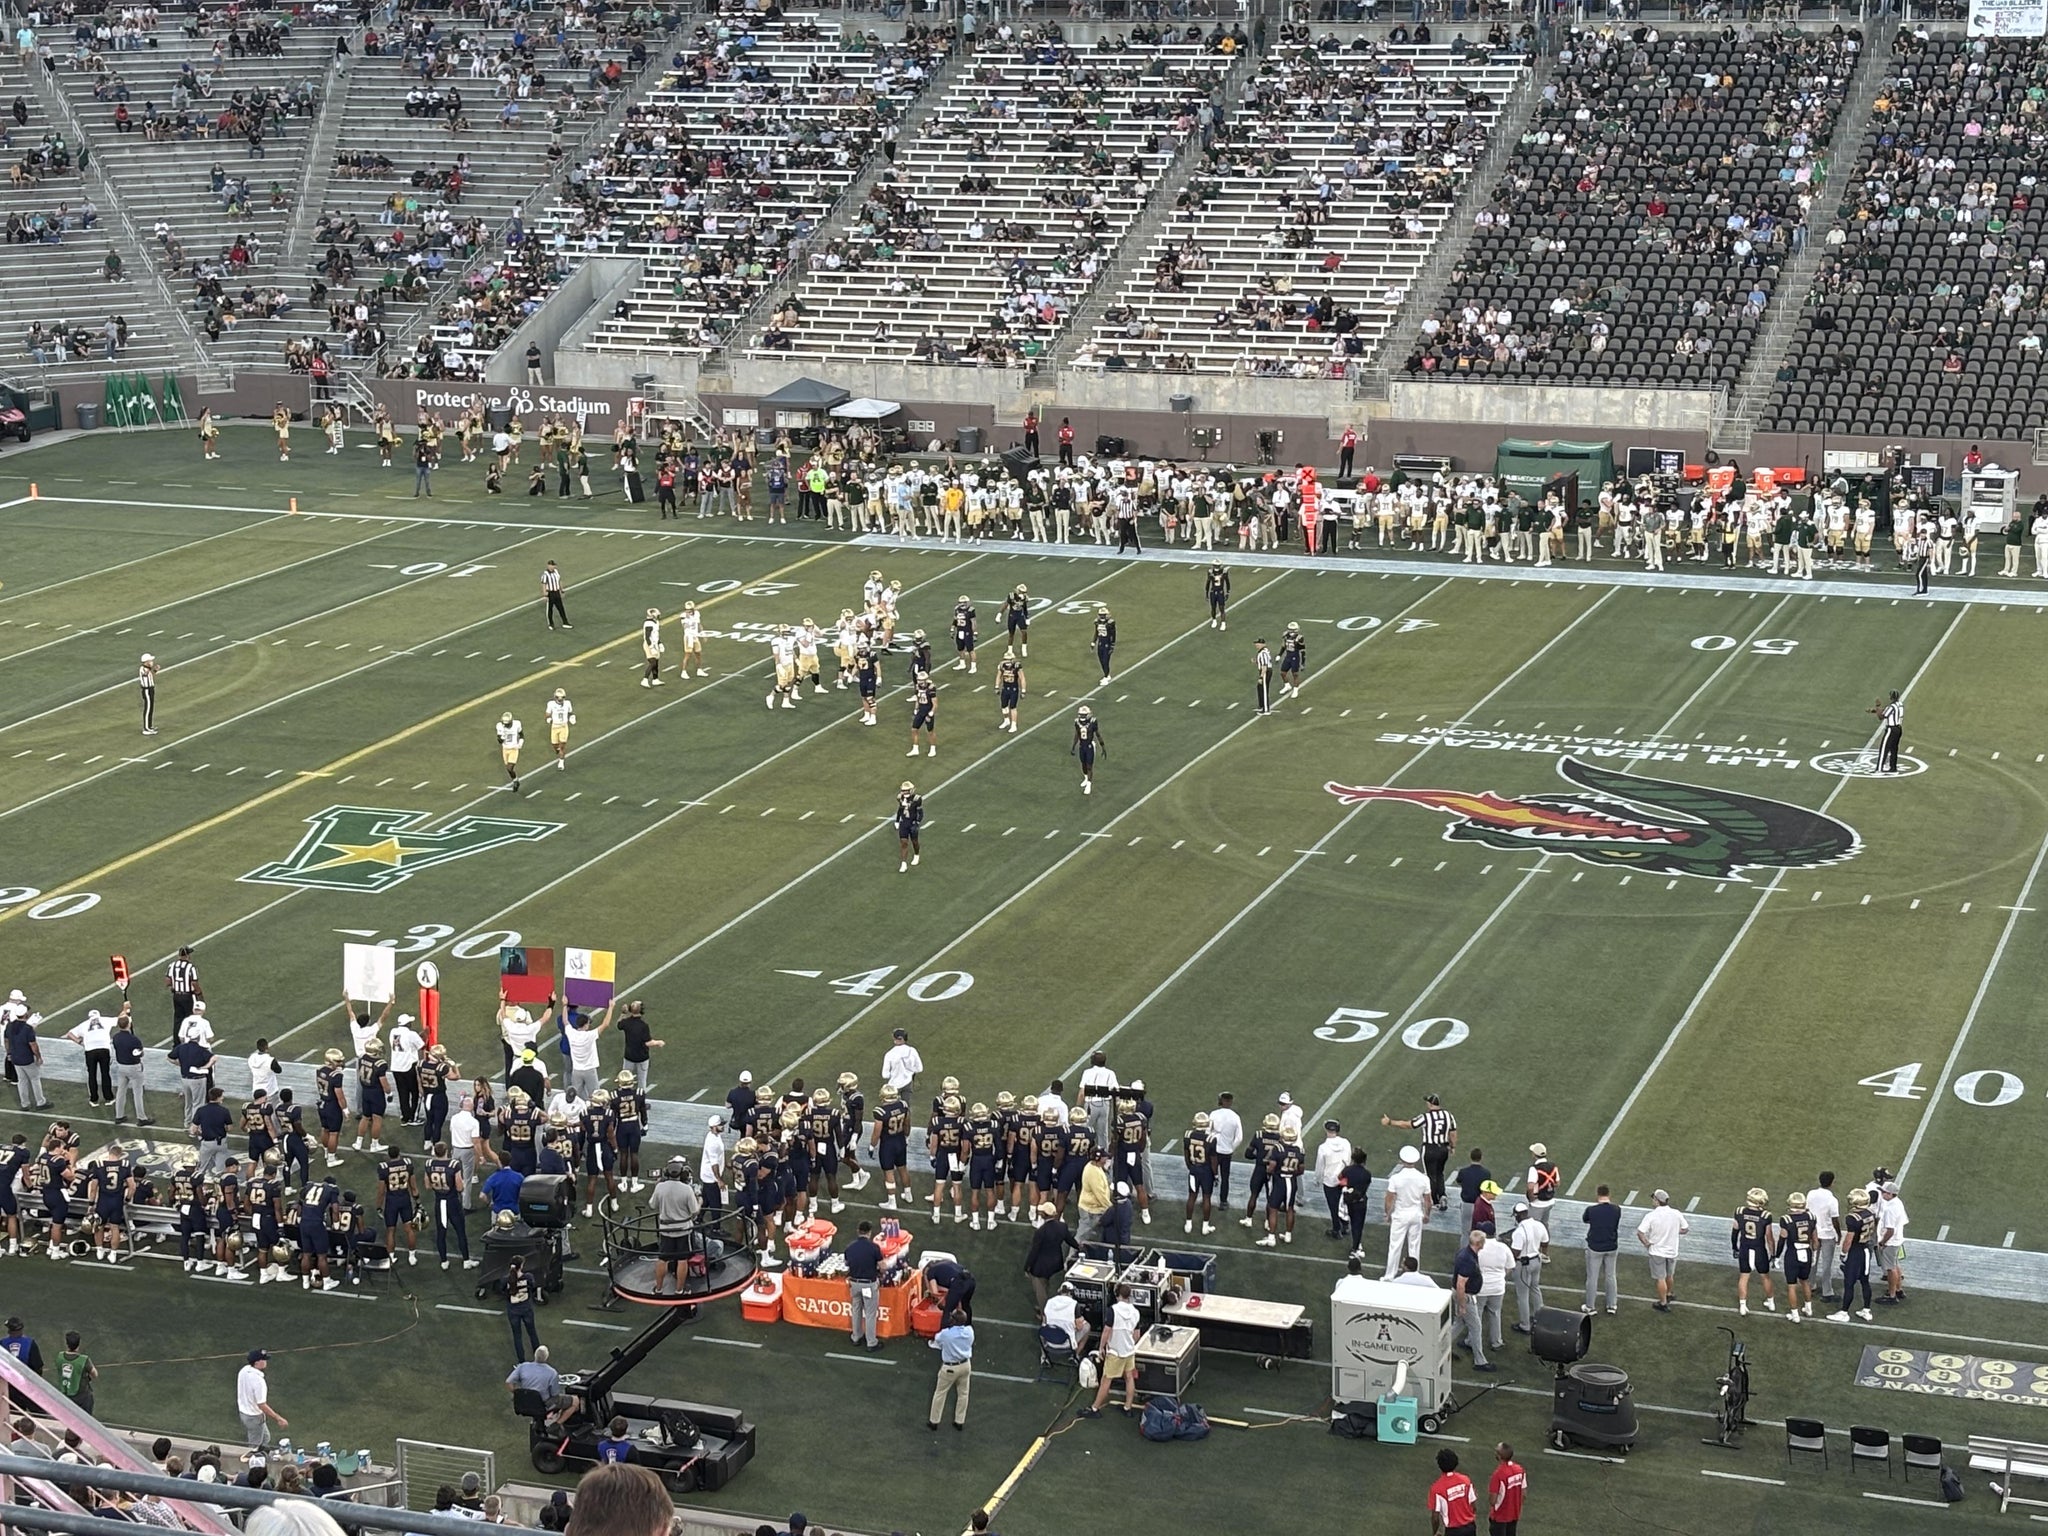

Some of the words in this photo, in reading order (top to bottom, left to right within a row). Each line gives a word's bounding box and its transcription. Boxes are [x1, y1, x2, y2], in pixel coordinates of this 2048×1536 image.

[539, 395, 611, 415] Stadium
[696, 579, 800, 597] 20
[1336, 615, 1440, 634] 40
[1690, 635, 1799, 655] 50
[1375, 732, 1689, 763] HEALTHCARE
[1705, 755, 1801, 771] LLH
[175, 967, 184, 982] L
[827, 965, 975, 1002] 40
[1312, 1007, 1470, 1051] 50
[1857, 1062, 2025, 1107] 40
[618, 1102, 638, 1120] 21
[812, 1120, 830, 1138] 91
[1434, 1120, 1445, 1135] F
[938, 1127, 960, 1147] 35
[1189, 1144, 1206, 1164] 13
[105, 1171, 119, 1190] 3
[430, 1173, 450, 1191] 91
[305, 1186, 324, 1206] 41
[1744, 1221, 1757, 1240] 9
[1797, 1227, 1809, 1243] 5
[795, 1297, 892, 1322] GATORE
[1351, 1340, 1389, 1352] IN-GAME
[1390, 1344, 1418, 1355] VIDEO
[1889, 1351, 1903, 1361] 5
[1880, 1365, 1904, 1377] 10
[1941, 1357, 1954, 1368] 4
[1993, 1362, 2005, 1373] 3
[1882, 1380, 1960, 1397] NAVY
